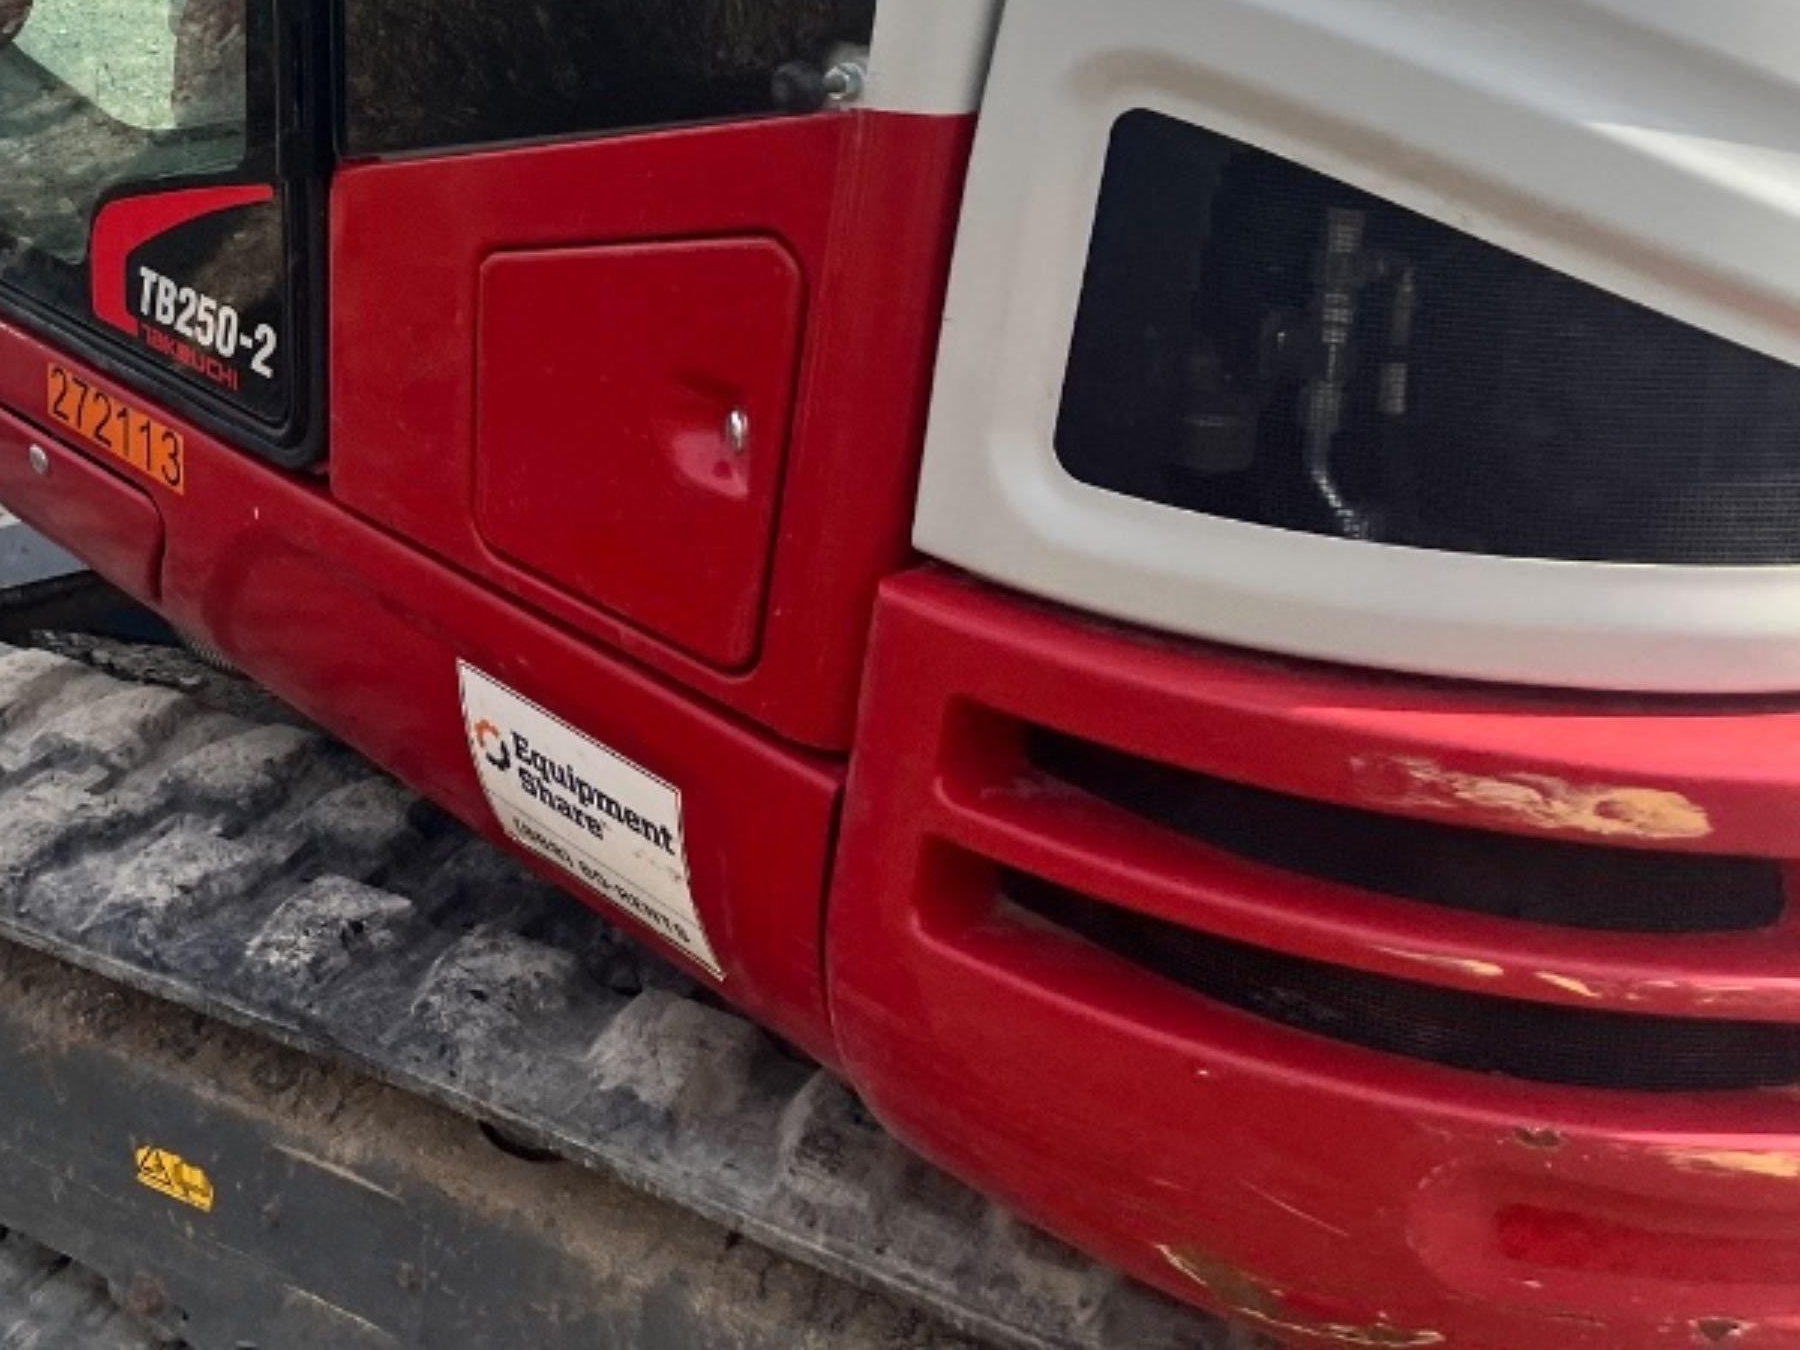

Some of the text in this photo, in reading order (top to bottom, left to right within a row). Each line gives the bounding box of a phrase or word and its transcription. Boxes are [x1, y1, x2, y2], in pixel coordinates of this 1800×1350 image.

[140, 265, 278, 380] TB250-2
[50, 367, 182, 488] 272113
[511, 730, 676, 856] Equipment
[518, 766, 605, 841] Share
